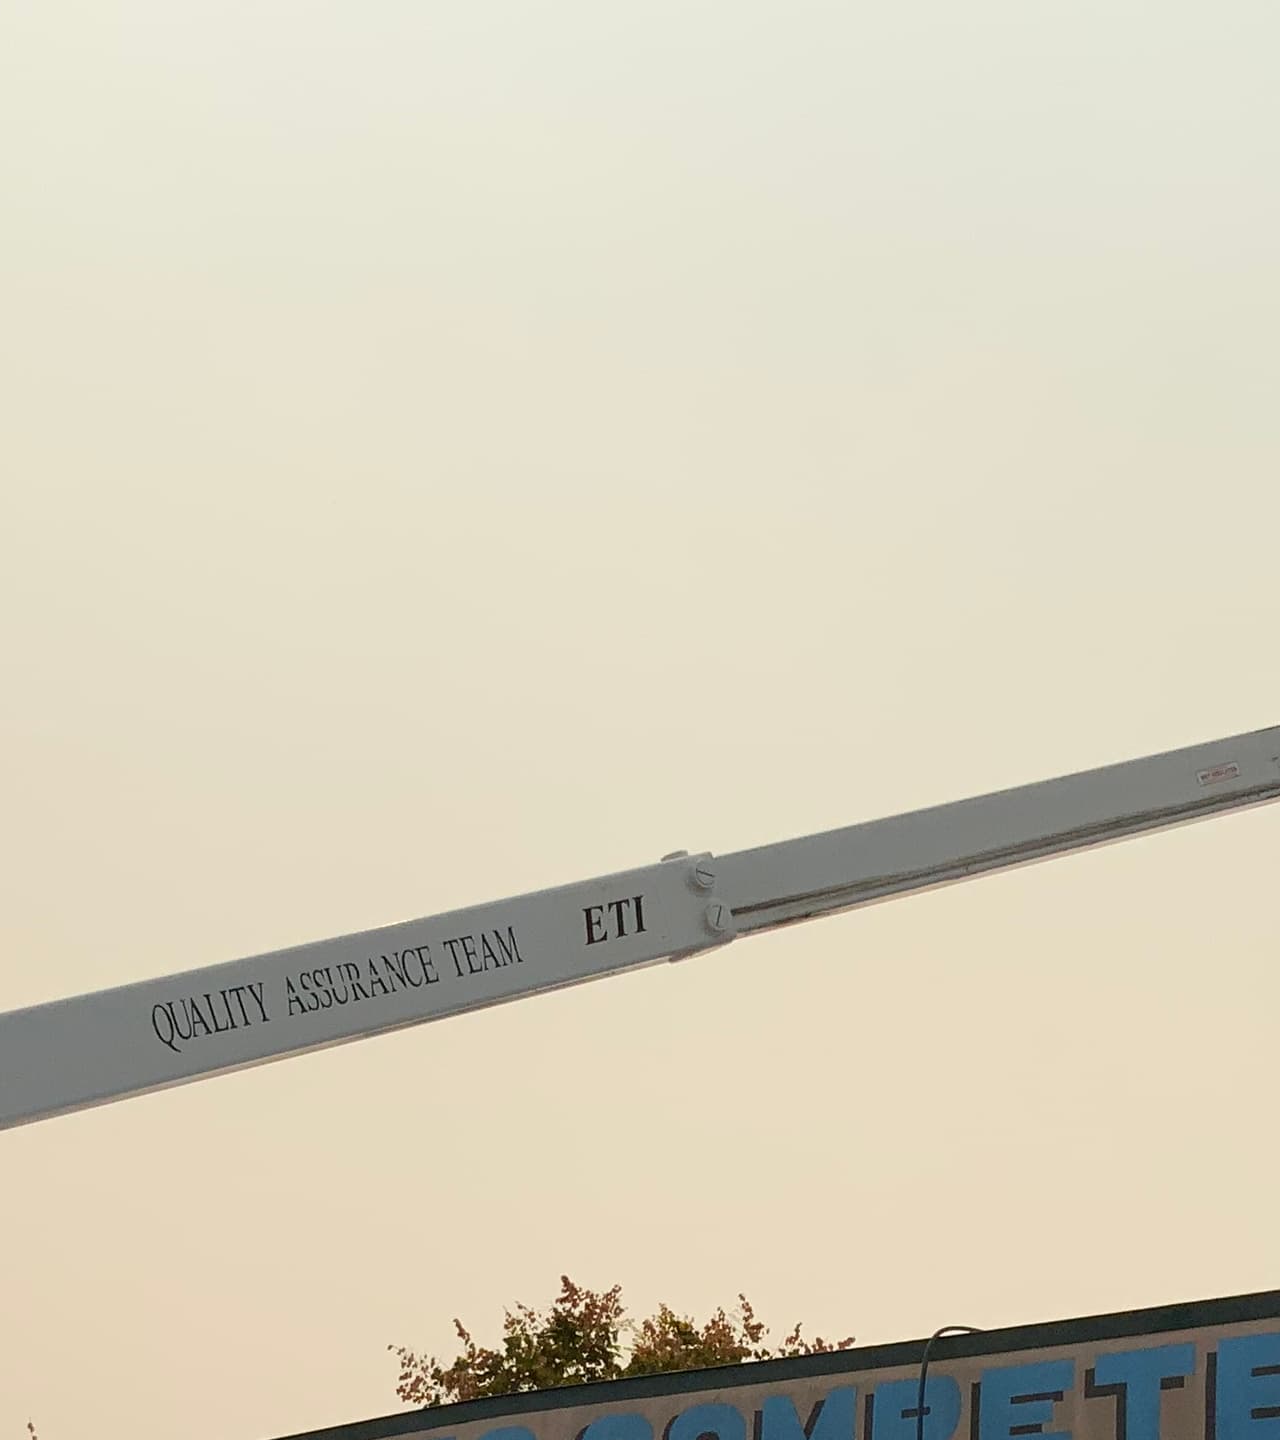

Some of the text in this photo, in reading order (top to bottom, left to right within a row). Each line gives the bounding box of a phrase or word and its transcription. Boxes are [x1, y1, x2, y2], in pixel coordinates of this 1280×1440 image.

[582, 895, 647, 945] ETI
[151, 925, 524, 1053] QUALITY ASSURANCE TEAM
